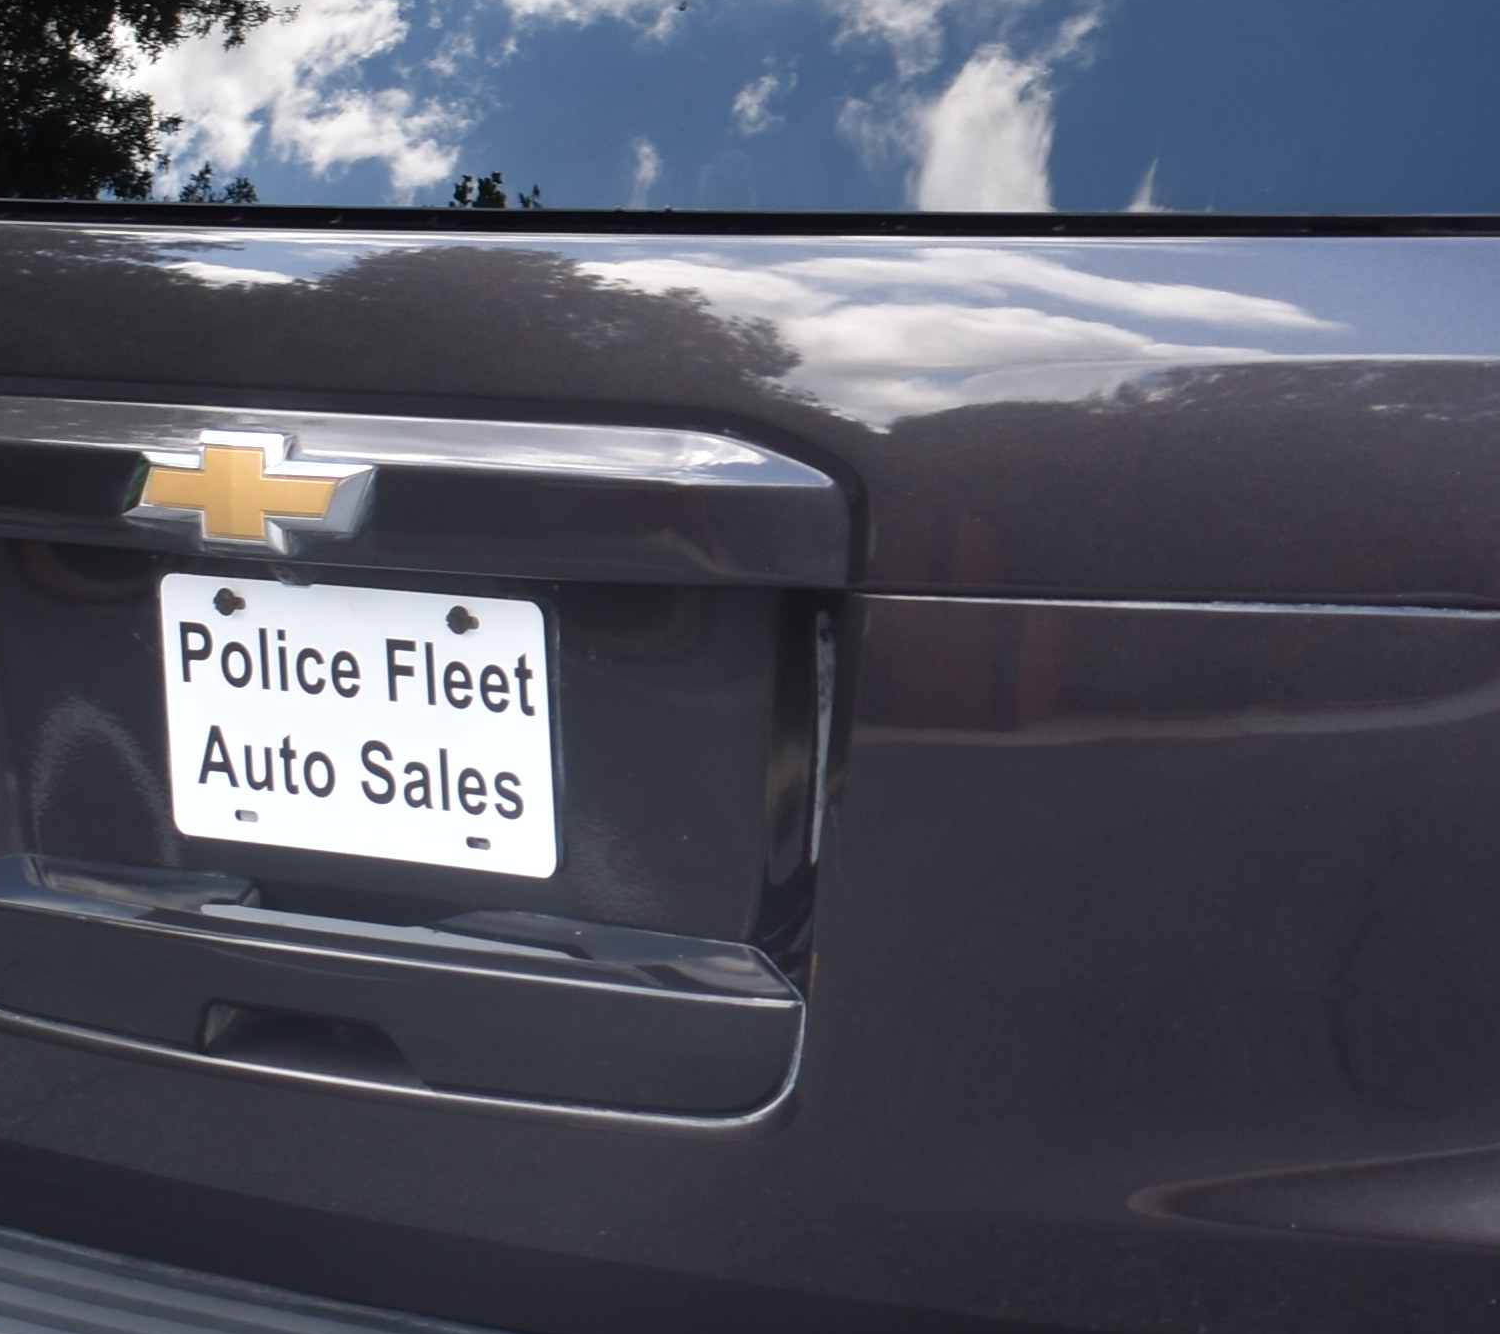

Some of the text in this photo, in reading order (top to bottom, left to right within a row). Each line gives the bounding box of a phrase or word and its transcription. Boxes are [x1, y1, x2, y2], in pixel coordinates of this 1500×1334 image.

[178, 621, 536, 717] Police Fleet
[198, 724, 525, 820] Auto Sales
